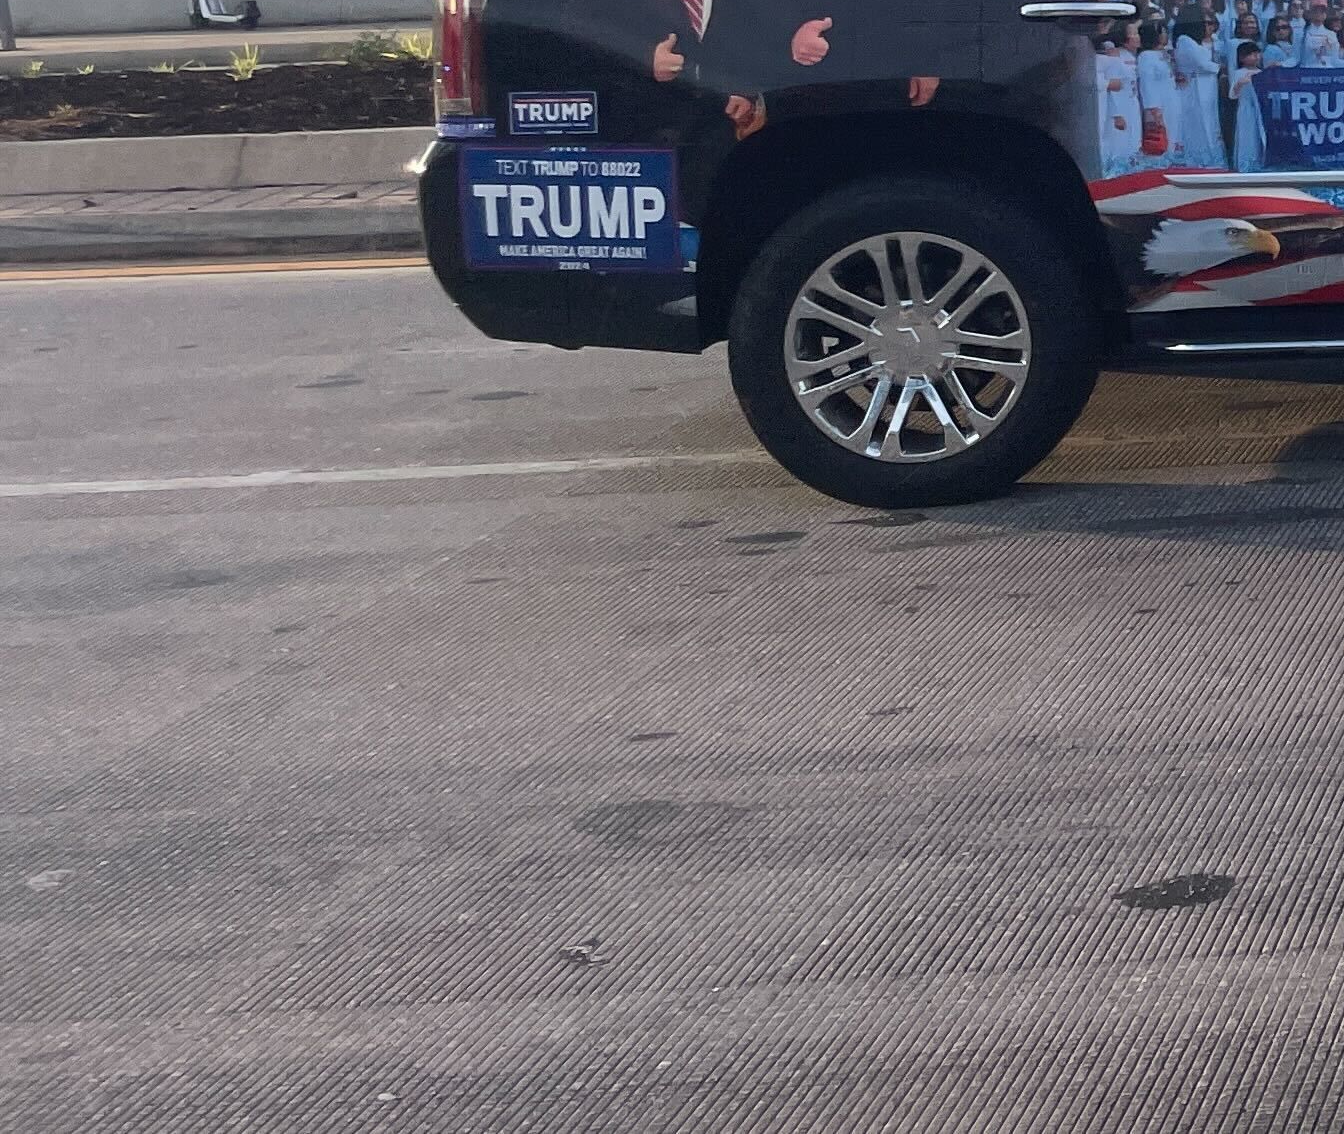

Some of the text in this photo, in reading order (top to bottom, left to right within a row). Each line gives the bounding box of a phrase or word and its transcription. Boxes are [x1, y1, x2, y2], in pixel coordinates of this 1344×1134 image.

[513, 103, 594, 122] TRUMP
[496, 160, 641, 177] TEXT TRUMP TO 88022
[473, 184, 666, 239] TRUMP
[499, 245, 528, 257] MAKE
[531, 245, 576, 258] AMERICA
[577, 246, 609, 258] GREAT
